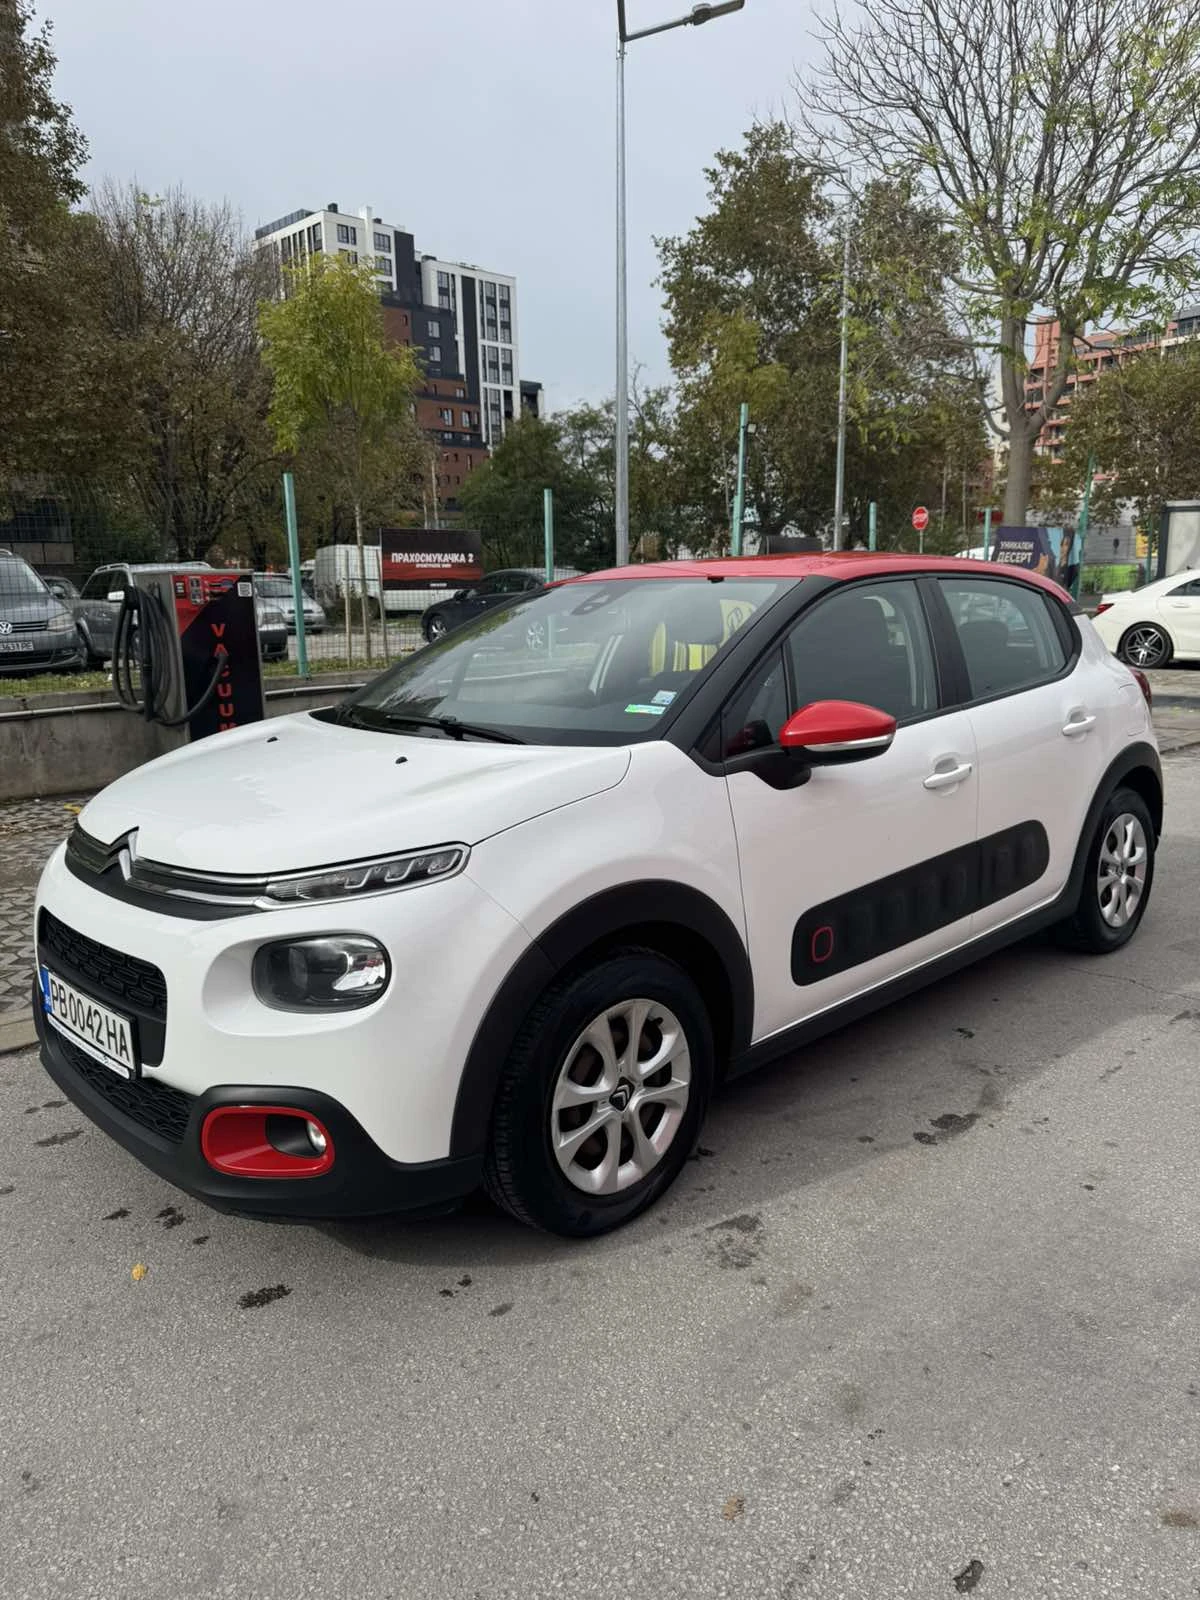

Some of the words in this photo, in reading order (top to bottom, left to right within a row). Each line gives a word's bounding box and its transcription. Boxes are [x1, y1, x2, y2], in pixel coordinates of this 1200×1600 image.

[391, 552, 466, 563] ПРАХОСМУКАЧКА
[467, 553, 474, 563] 2
[997, 551, 1033, 563] ДЕСЕРТ
